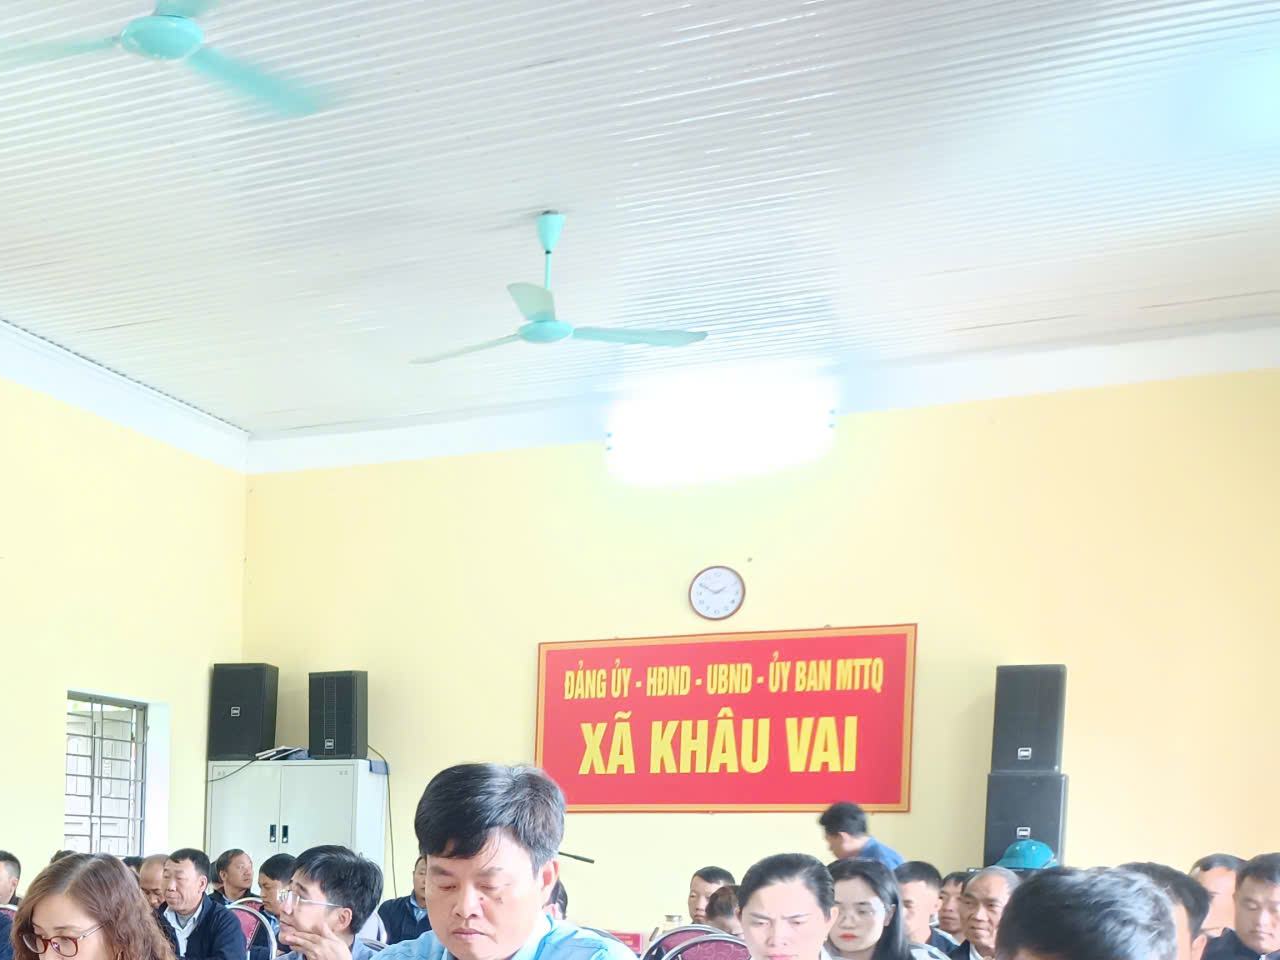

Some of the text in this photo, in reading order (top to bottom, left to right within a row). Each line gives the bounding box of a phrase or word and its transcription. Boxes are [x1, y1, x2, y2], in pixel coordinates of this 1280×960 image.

[564, 660, 607, 700] ĐẢNG
[610, 658, 632, 698] ỦY
[646, 665, 691, 697] HĐND
[706, 663, 753, 696] UBND
[768, 651, 792, 693] ỦY
[795, 659, 832, 692] BAN
[836, 657, 884, 693] MTTQ
[578, 706, 858, 775] XÃ KHÂU VAI
